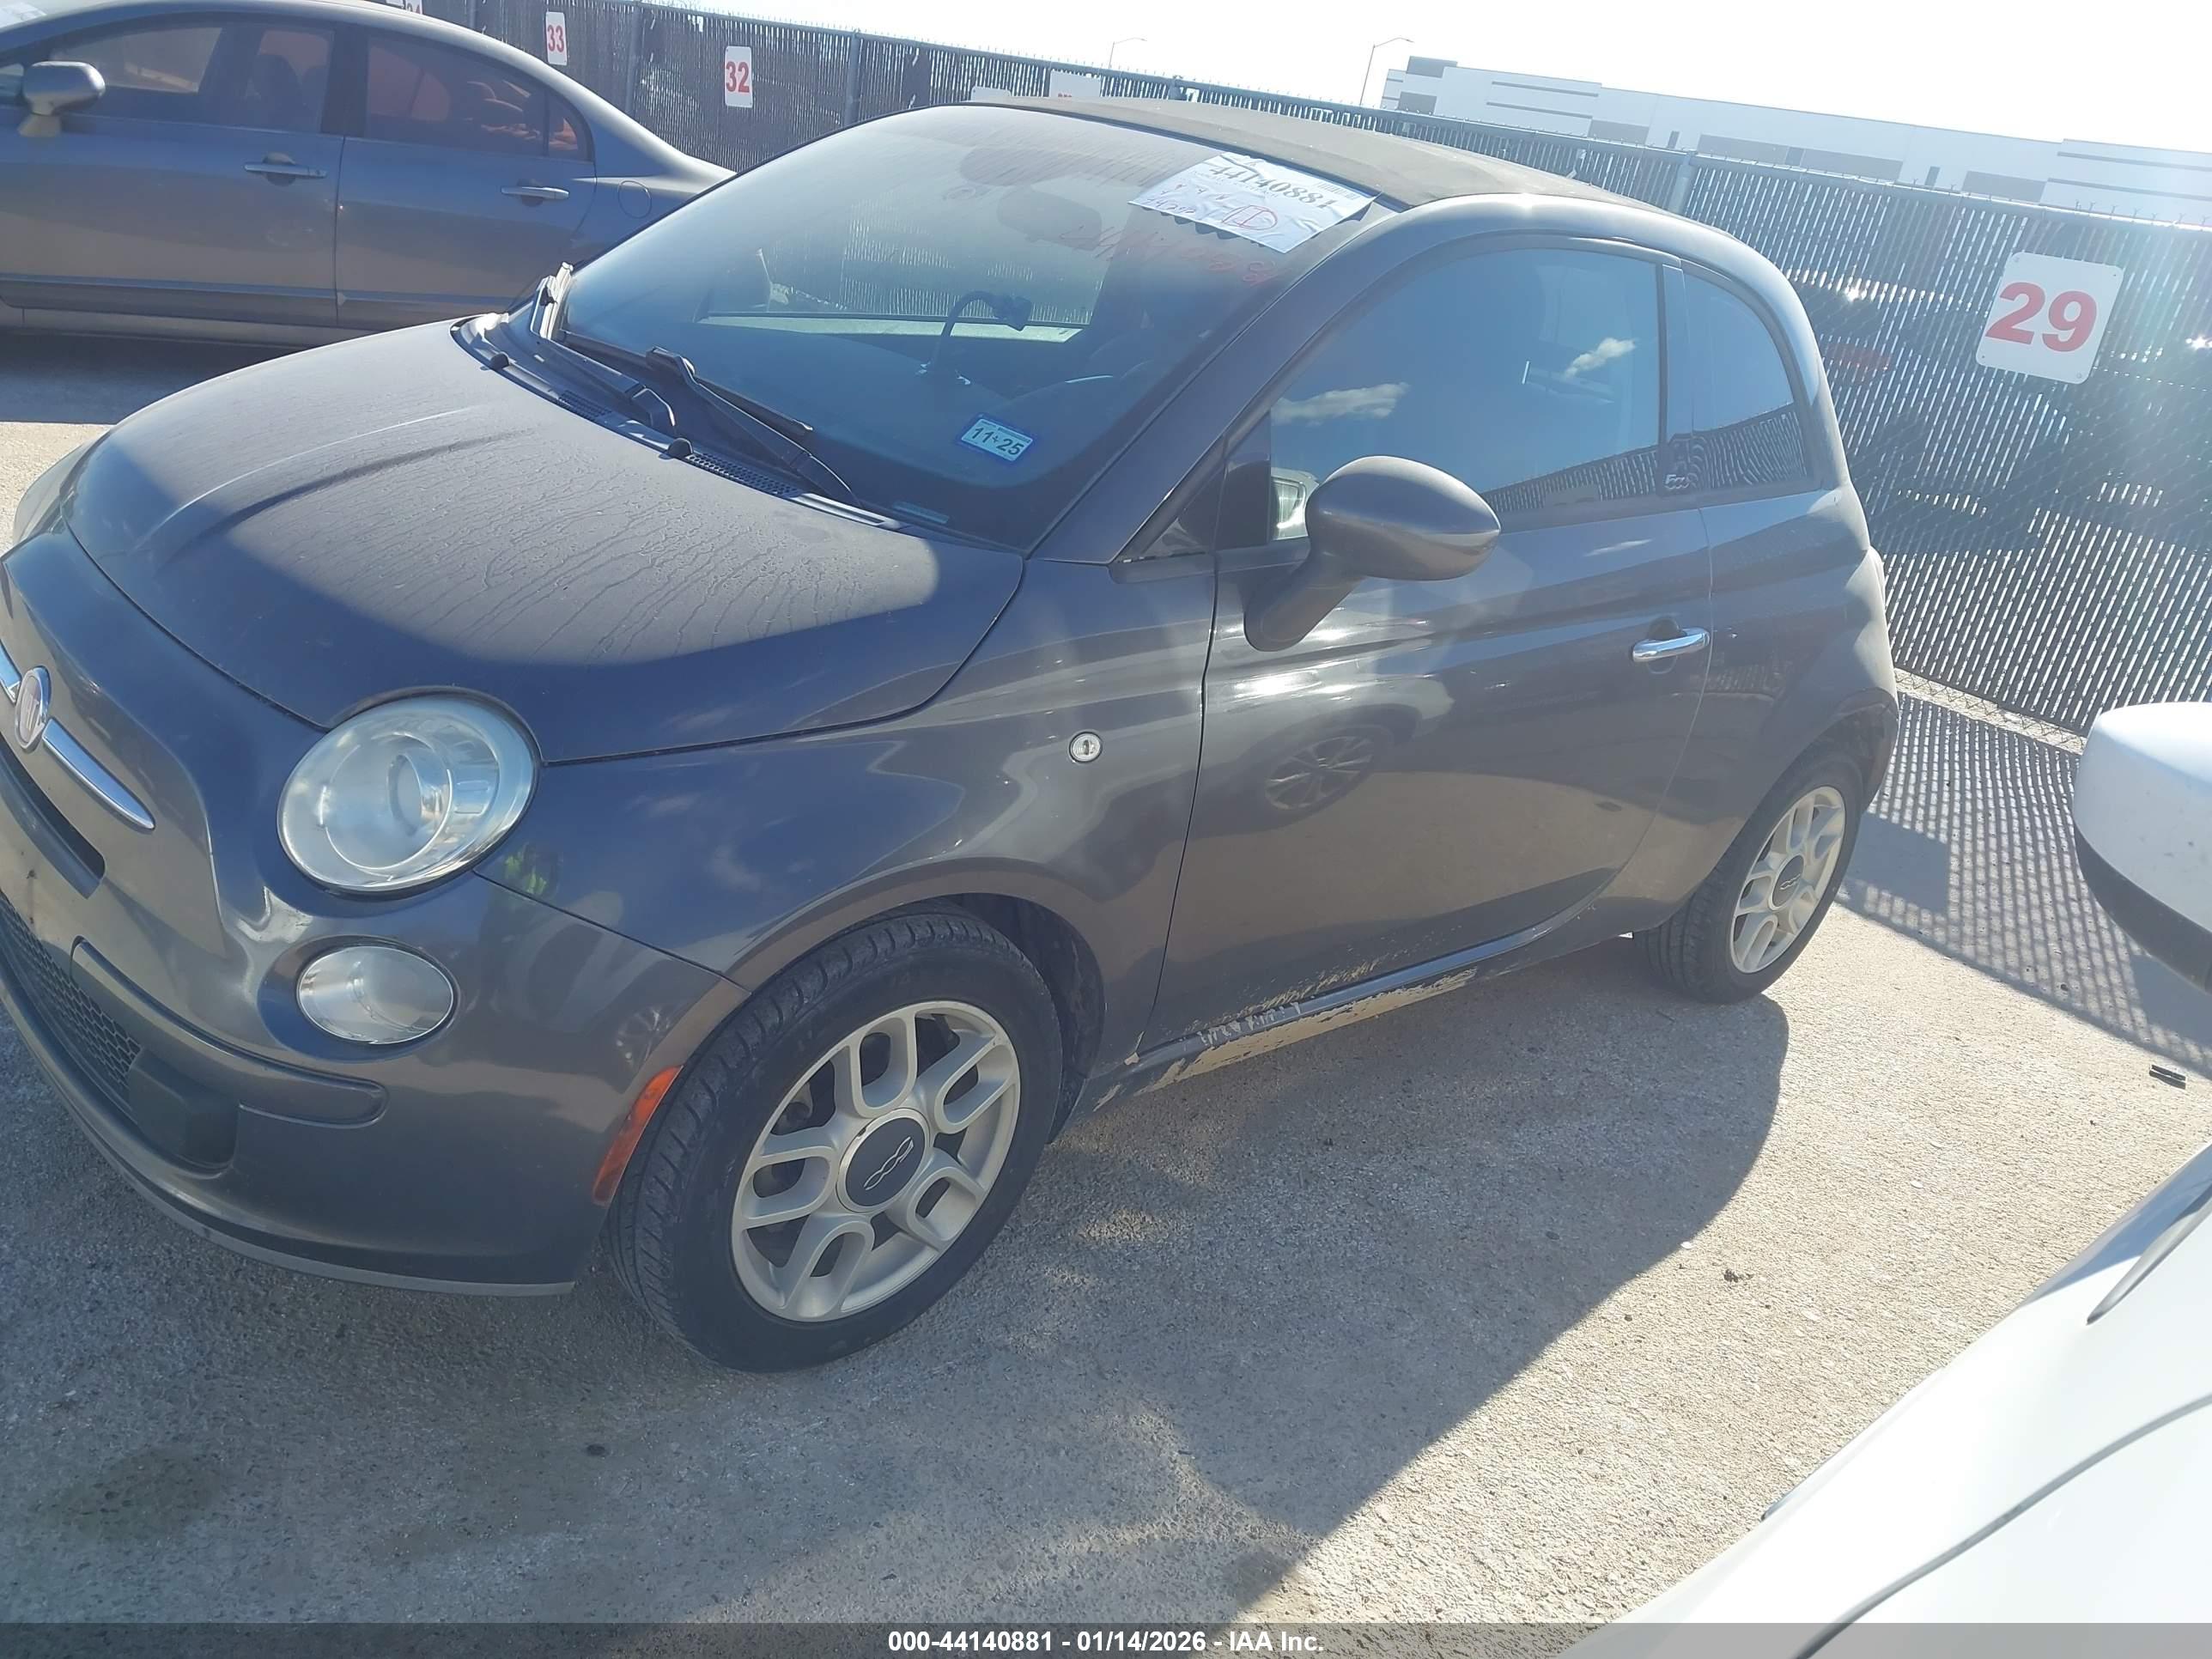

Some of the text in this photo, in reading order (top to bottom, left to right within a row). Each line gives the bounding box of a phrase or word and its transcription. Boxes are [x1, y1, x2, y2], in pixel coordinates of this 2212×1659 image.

[547, 24, 565, 52] 33
[726, 61, 750, 94] 32
[1209, 166, 1340, 210] 44140881
[1985, 282, 2097, 352] 29
